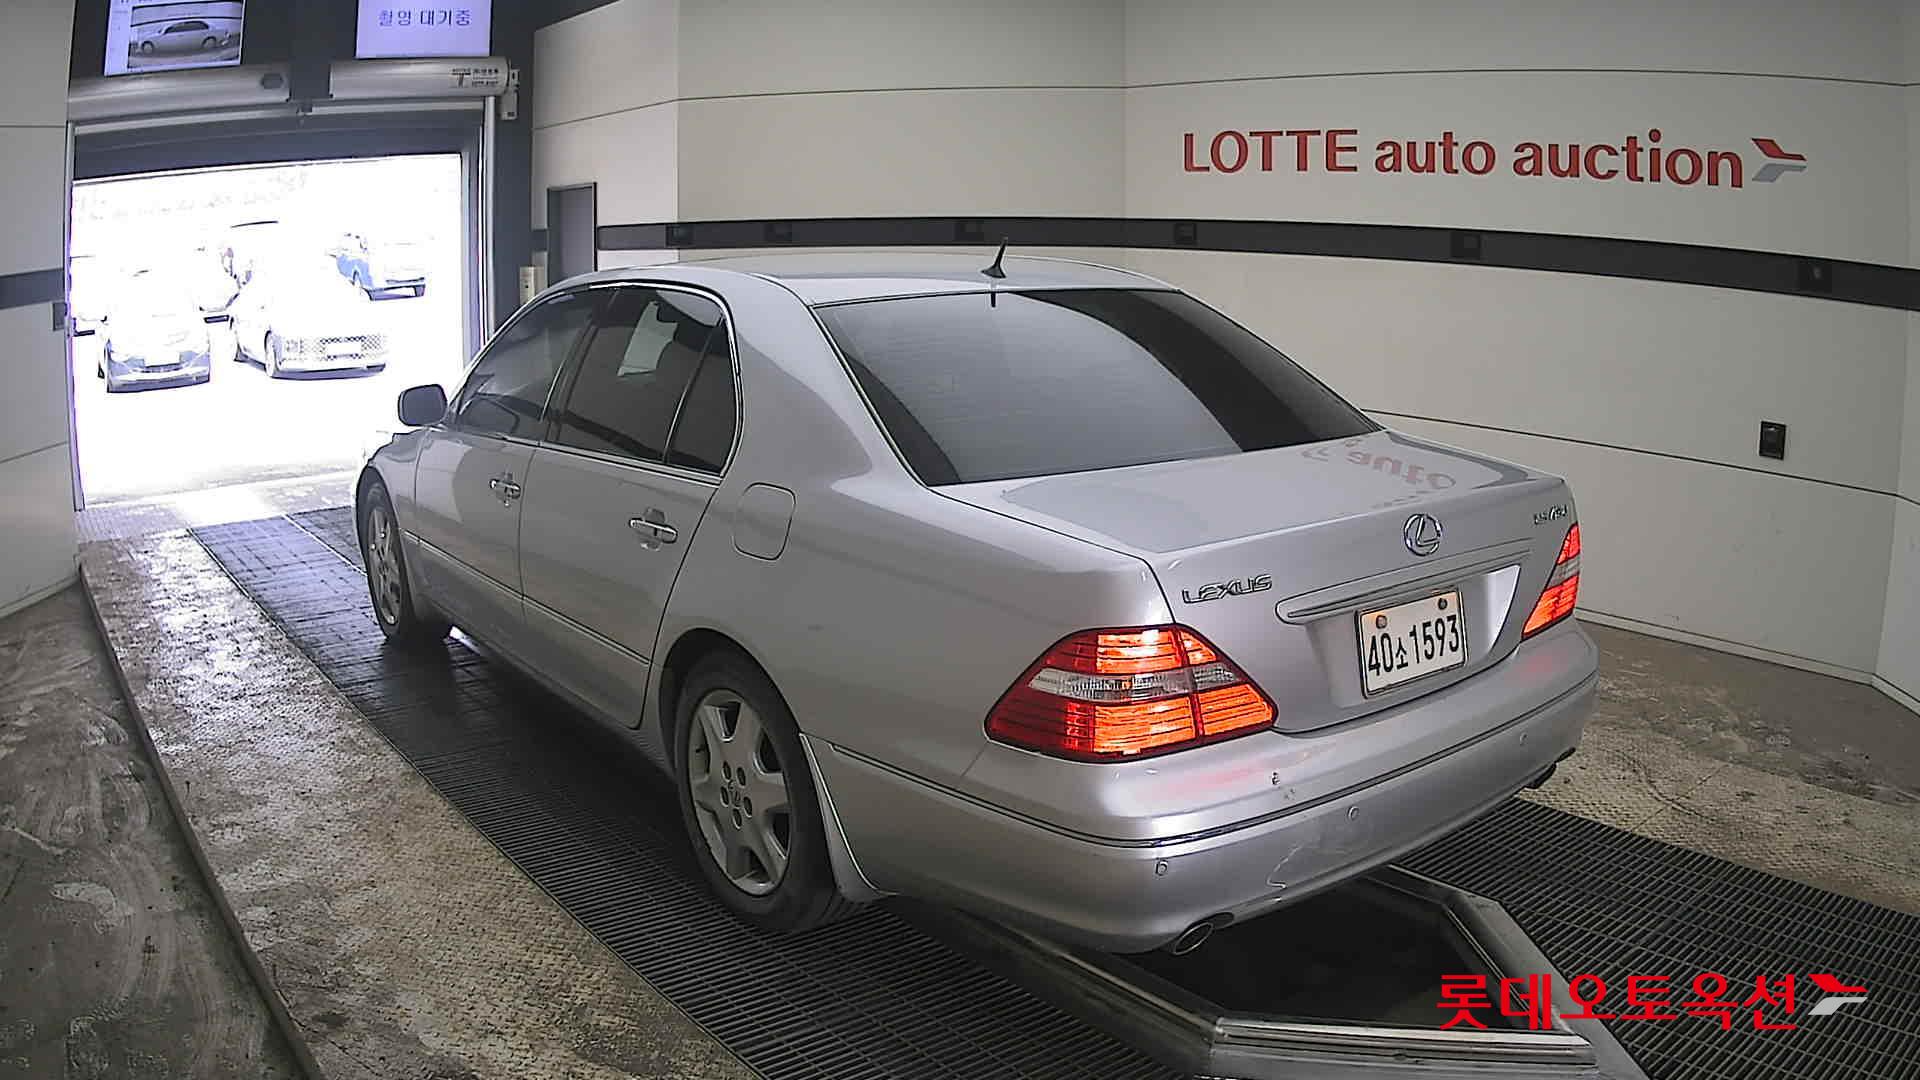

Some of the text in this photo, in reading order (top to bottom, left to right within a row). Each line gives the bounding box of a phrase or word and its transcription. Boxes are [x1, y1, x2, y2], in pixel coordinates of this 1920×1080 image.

[420, 9, 470, 26] 대기중
[1184, 128, 1744, 189] LOTTE auto auction
[1181, 574, 1273, 604] LEXUS
[1368, 614, 1461, 676] 40소1593
